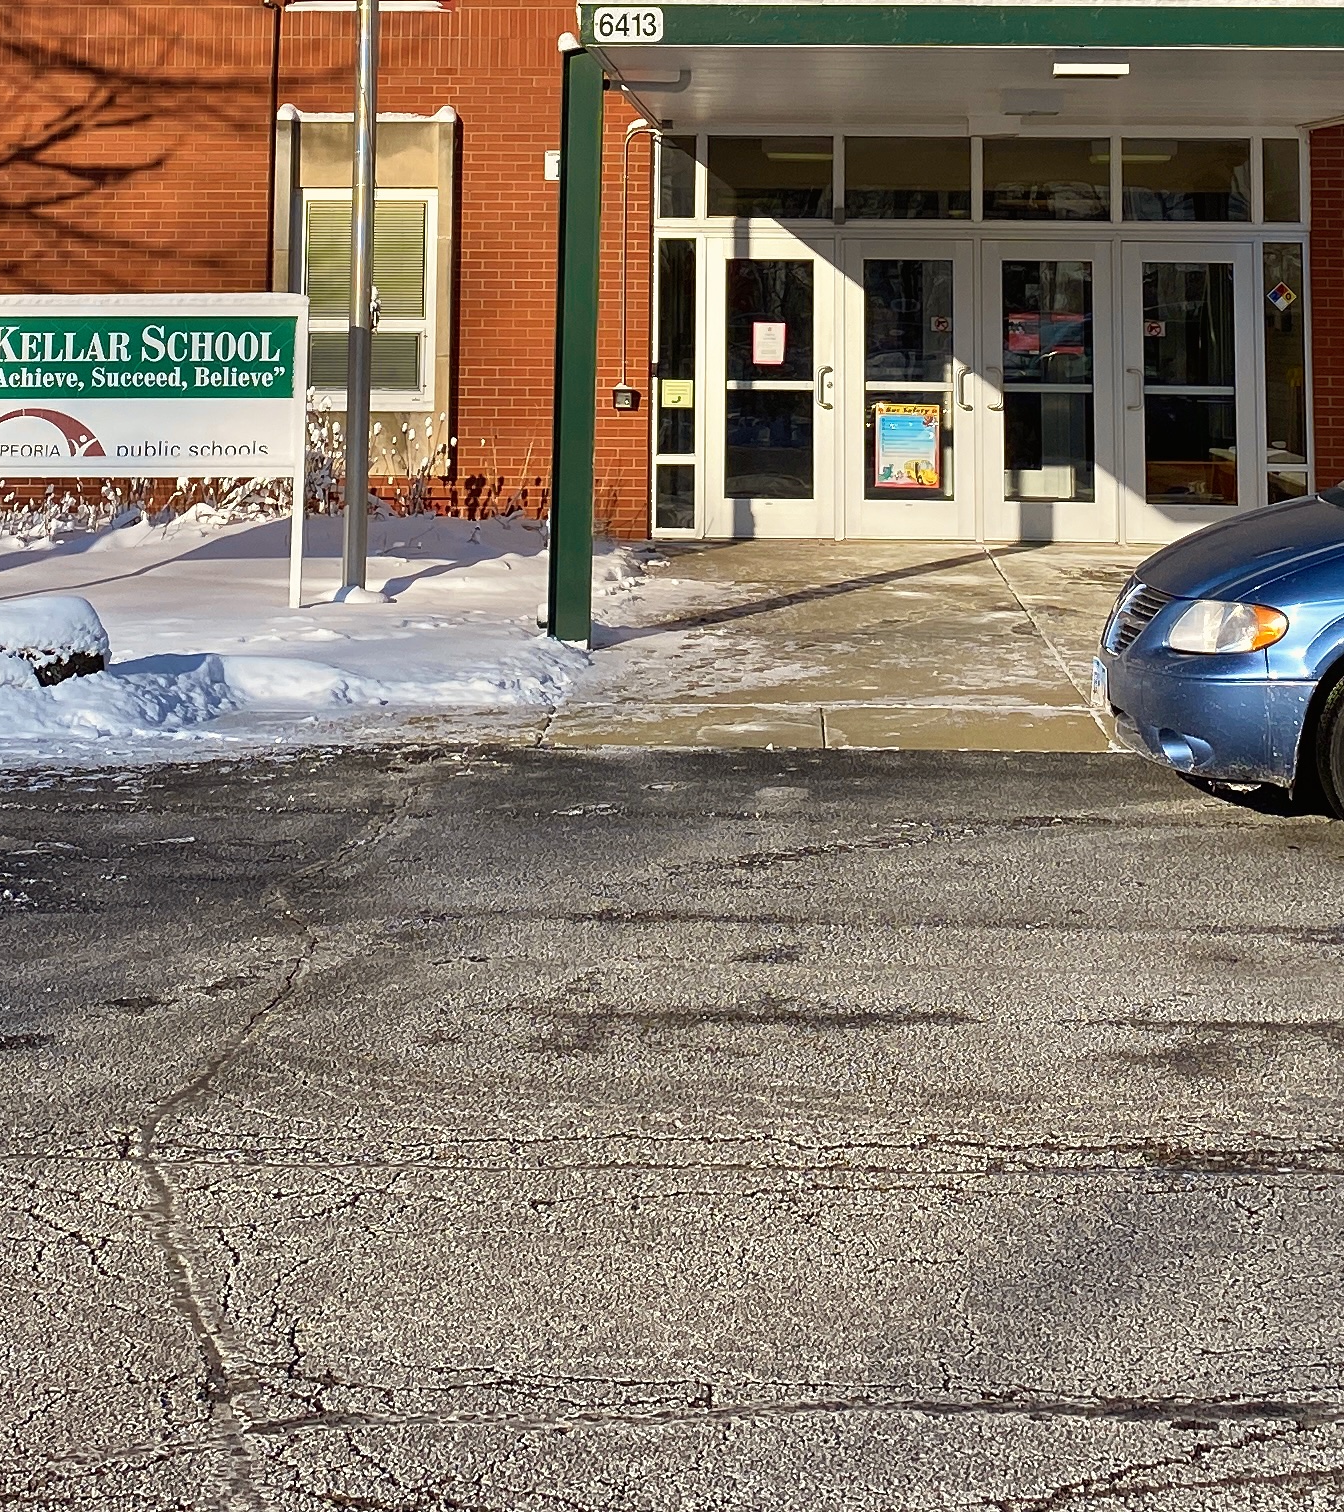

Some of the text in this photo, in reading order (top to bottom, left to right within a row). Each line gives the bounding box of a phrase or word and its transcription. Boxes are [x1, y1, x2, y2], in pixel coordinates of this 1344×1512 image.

[599, 12, 657, 37] 6413
[141, 324, 281, 362] SCHOOL
[91, 366, 188, 392] Succeed,
[0, 440, 269, 457] PEORIA public schools
